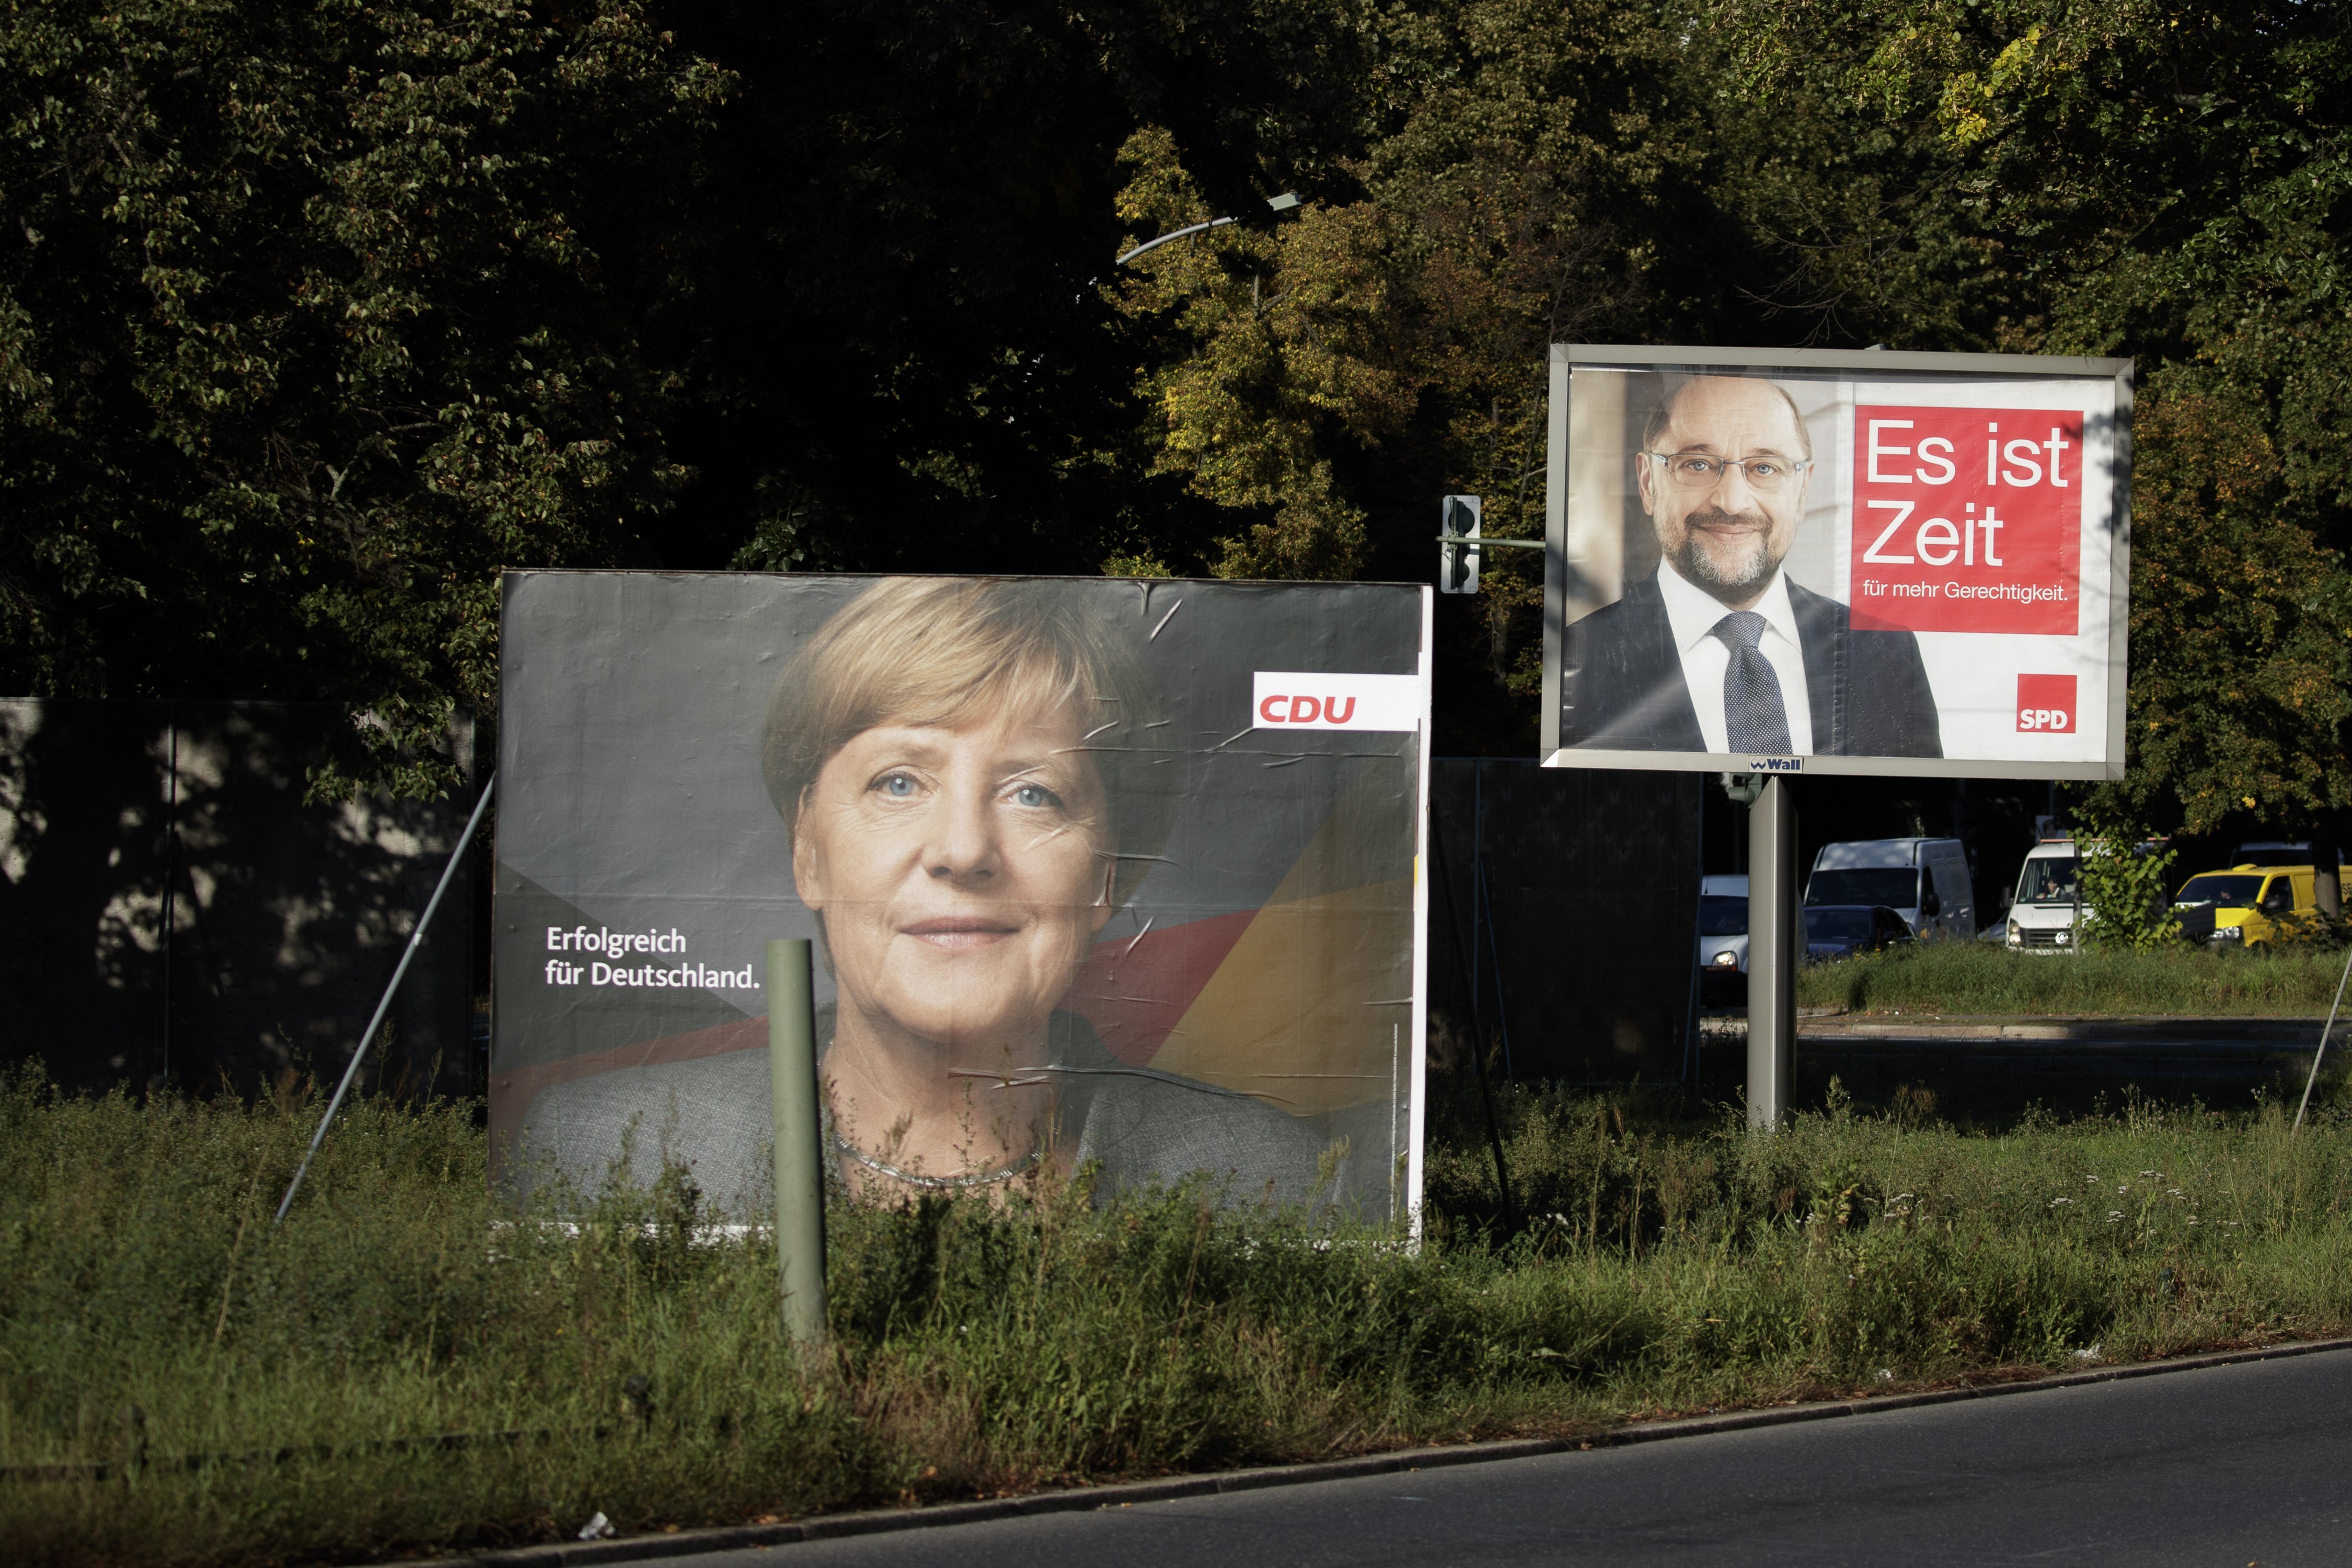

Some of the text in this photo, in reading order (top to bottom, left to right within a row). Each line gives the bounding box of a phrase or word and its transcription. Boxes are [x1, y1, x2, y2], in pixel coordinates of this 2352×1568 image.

[1867, 419, 2069, 488] Es ist
[1863, 500, 2004, 567] Zeit
[1862, 579, 2068, 604] für mehr Gerechtigkeit.
[1260, 695, 1355, 724] CDU
[2020, 709, 2068, 730] SPD
[1767, 758, 1801, 770] Wall
[548, 926, 686, 959] Erfolgreich
[545, 959, 760, 989] für Deutschland.
